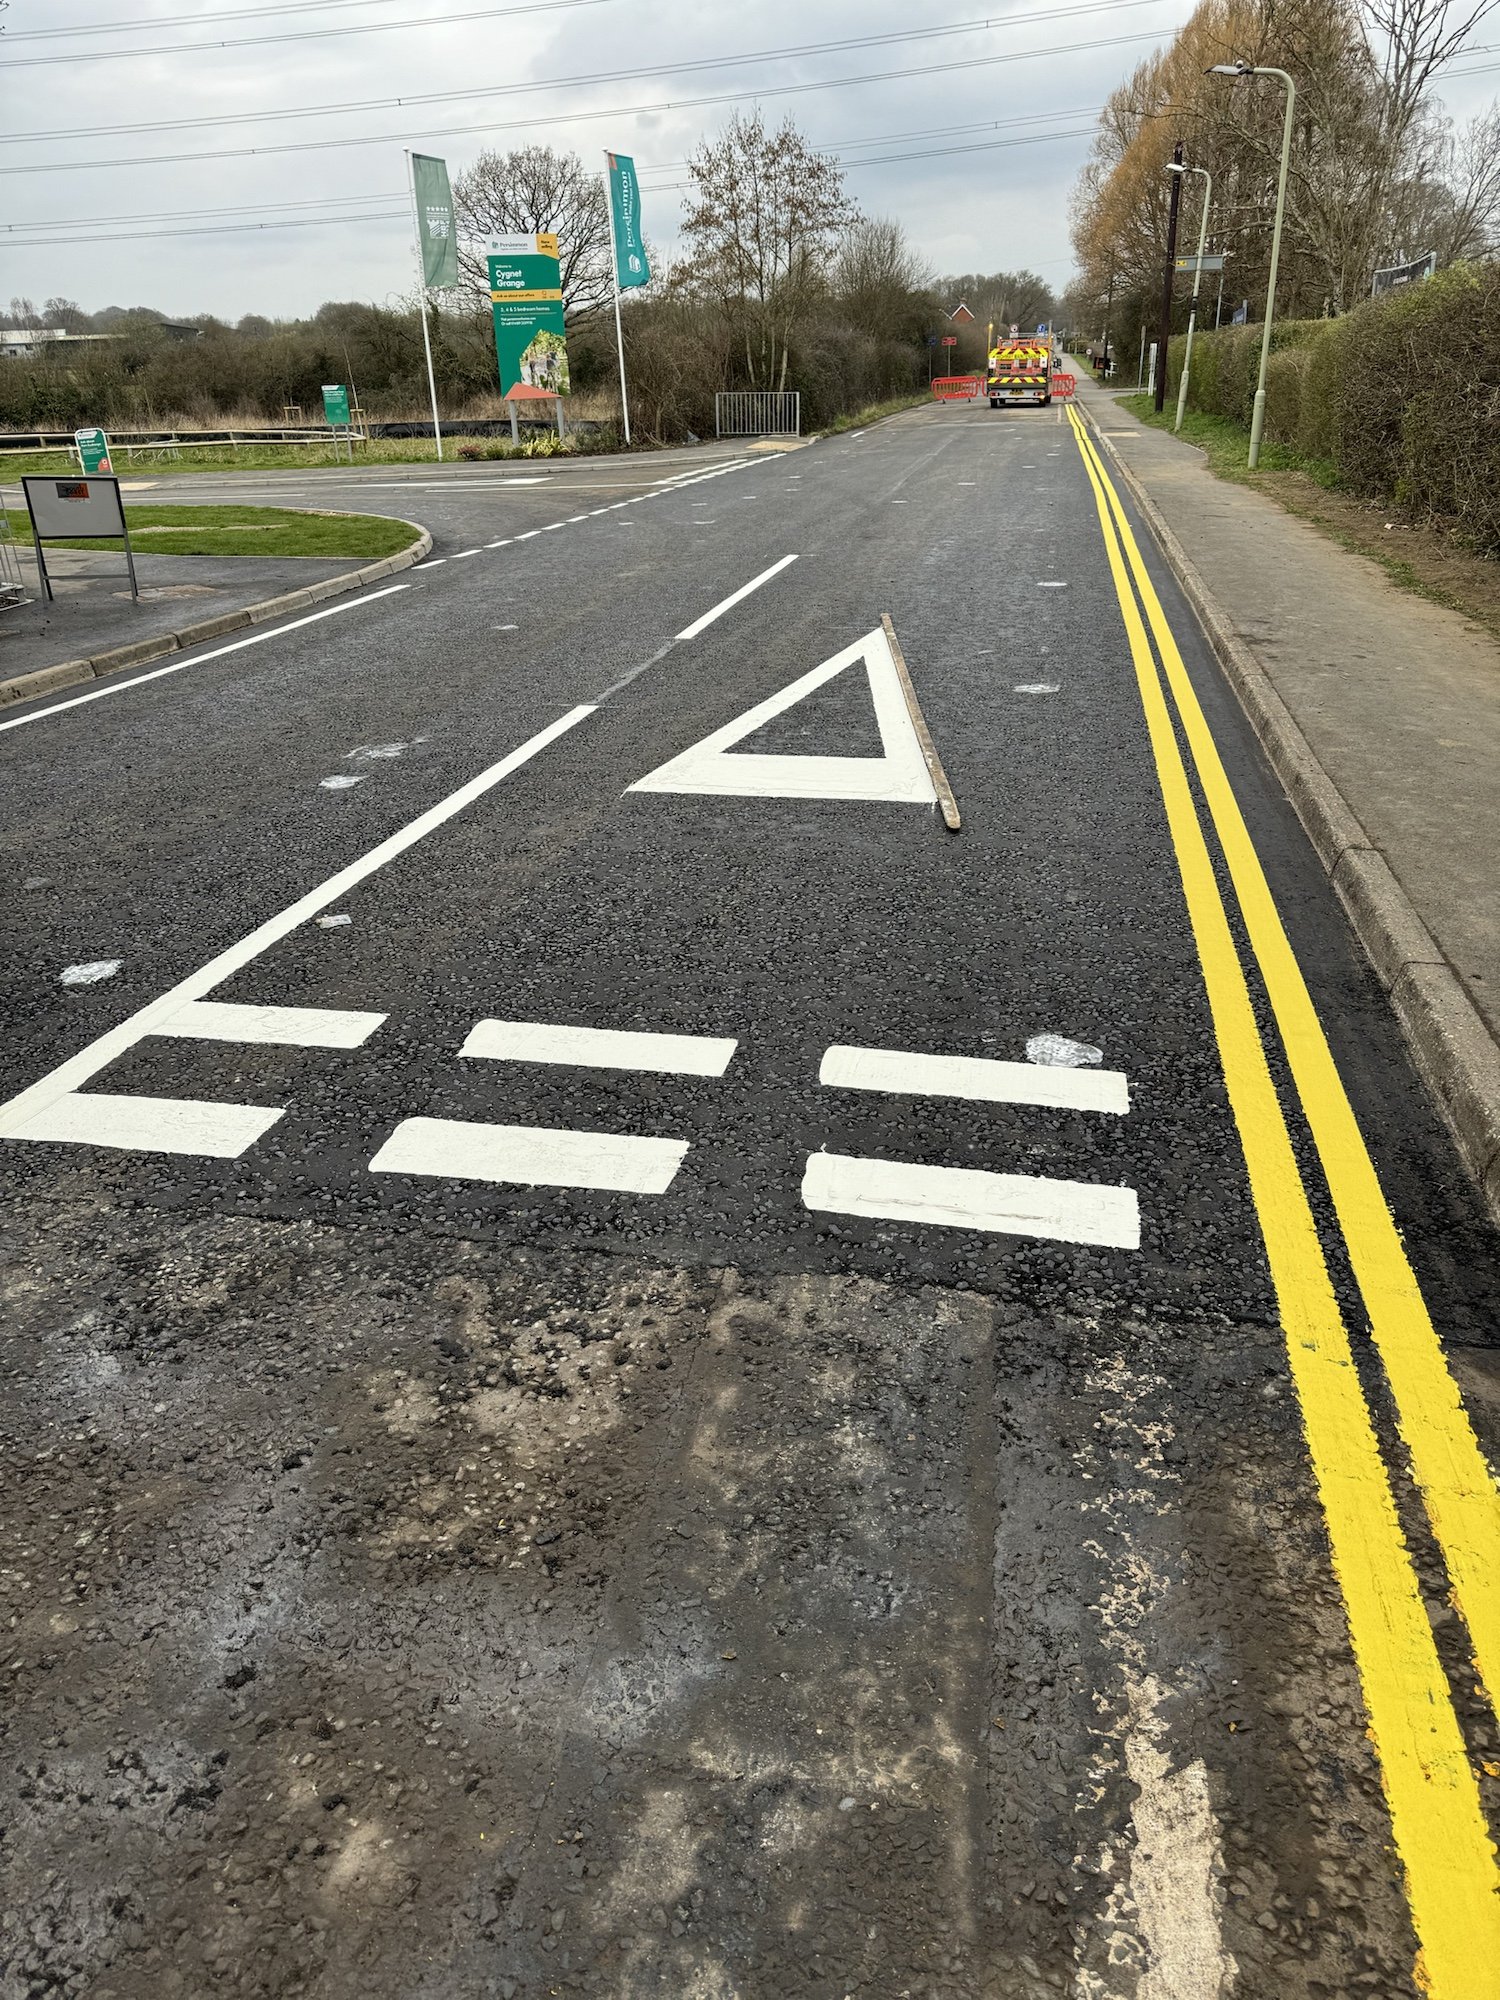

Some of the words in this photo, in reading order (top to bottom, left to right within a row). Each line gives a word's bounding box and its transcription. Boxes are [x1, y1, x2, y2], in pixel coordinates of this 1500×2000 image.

[621, 171, 633, 248] Persimmon
[496, 270, 522, 279] Cygnet
[497, 279, 525, 289] Grange
